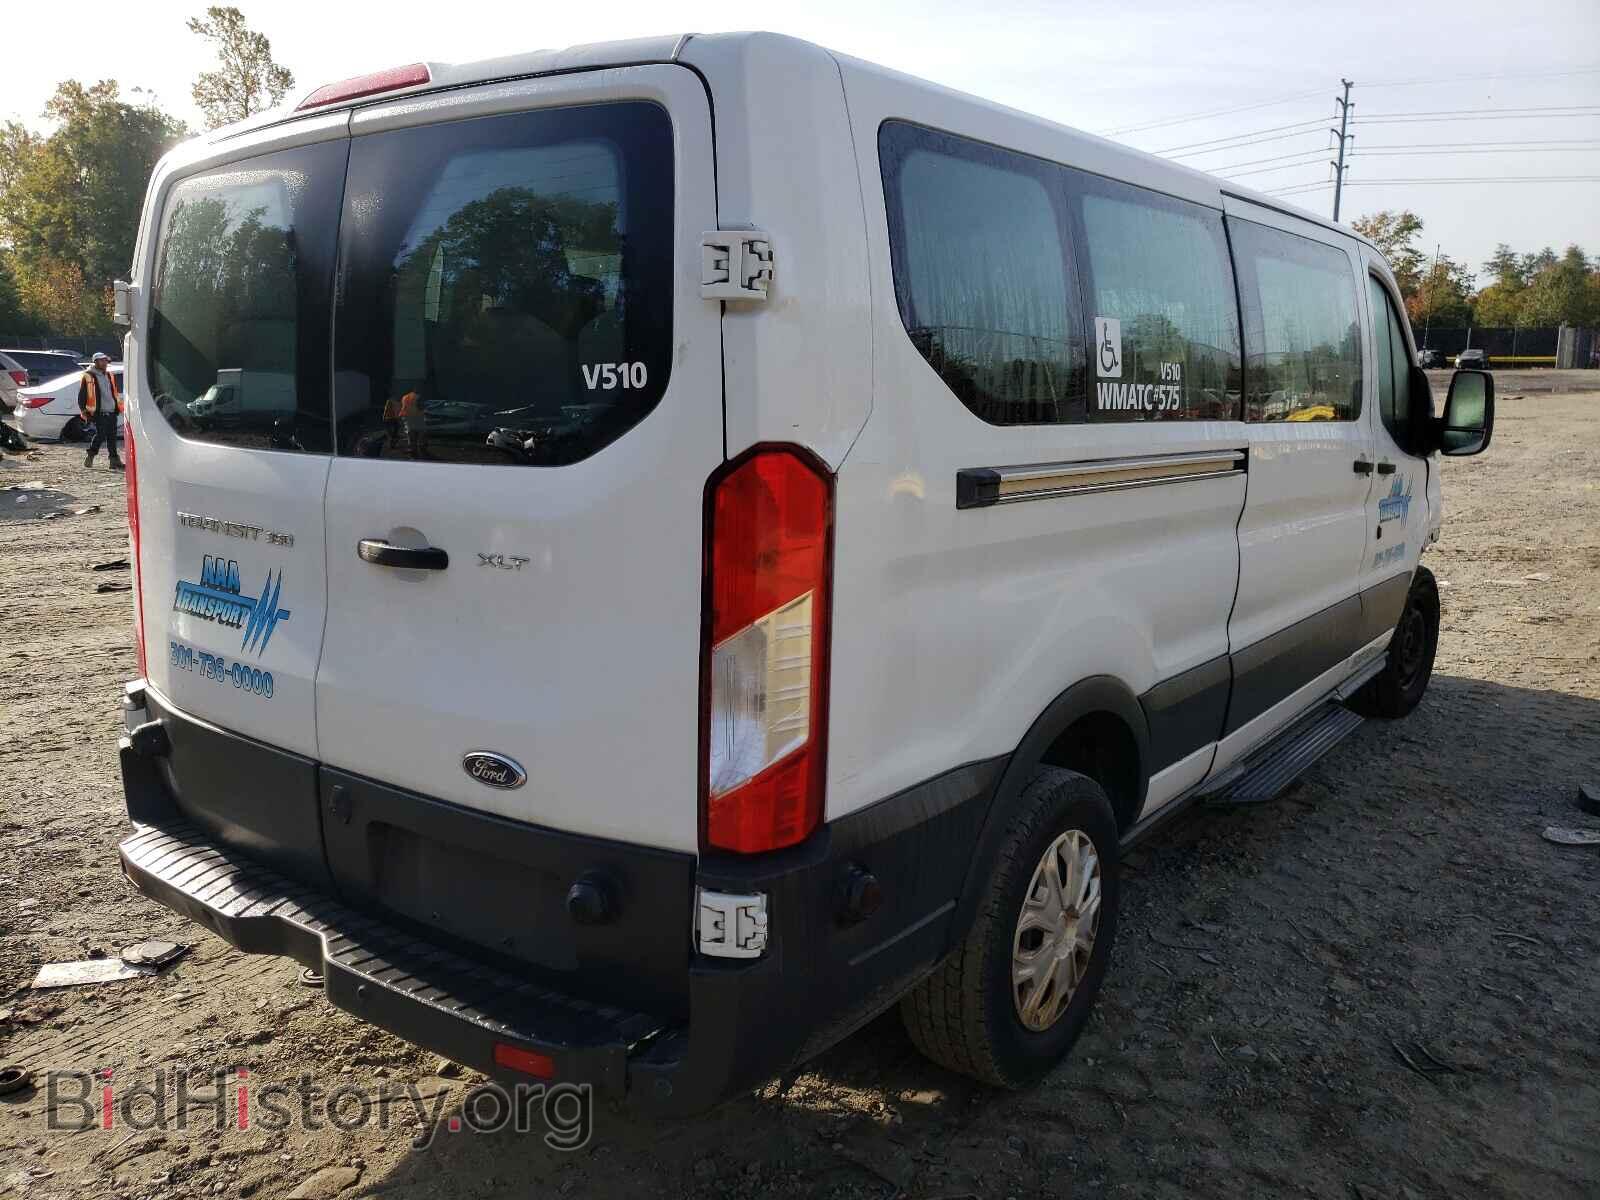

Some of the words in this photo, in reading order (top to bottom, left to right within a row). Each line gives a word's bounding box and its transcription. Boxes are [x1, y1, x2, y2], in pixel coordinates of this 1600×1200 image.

[582, 362, 648, 390] V510
[1160, 361, 1181, 381] V510
[1097, 382, 1180, 410] WMATC#575
[177, 511, 263, 541] TRANSIT
[201, 554, 240, 594] AAA
[477, 552, 530, 571] XLT
[173, 582, 251, 629] TRANSPORT
[170, 641, 274, 699] 301-736-0000
[472, 758, 508, 783] Ford
